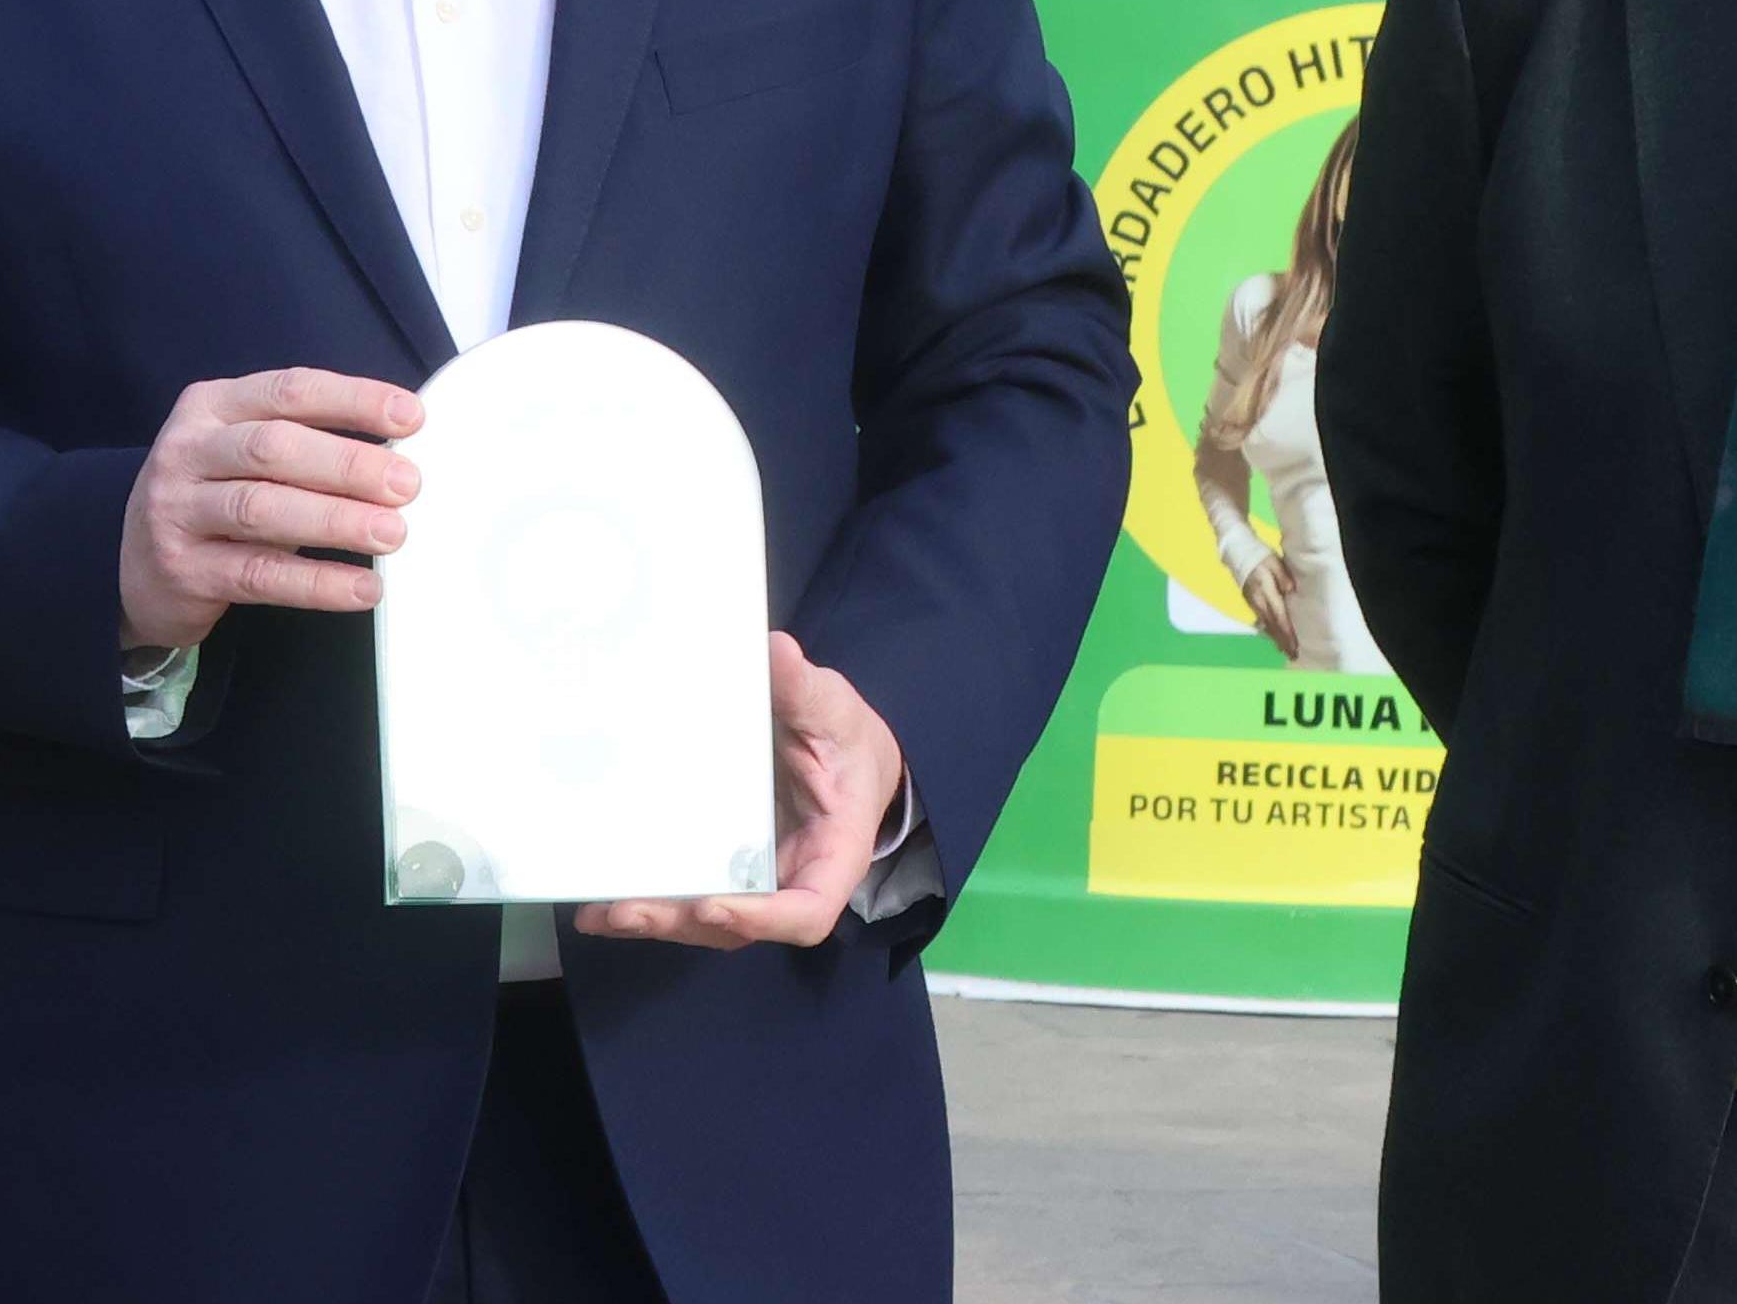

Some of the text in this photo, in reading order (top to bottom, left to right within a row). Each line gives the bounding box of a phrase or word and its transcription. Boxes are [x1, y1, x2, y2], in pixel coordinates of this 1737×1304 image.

[1263, 691, 1402, 732] LUNA
[1217, 760, 1365, 792] RECICLA
[1129, 794, 1198, 823] POR
[1210, 797, 1254, 825] TU
[1265, 800, 1412, 831] ARTISTA
